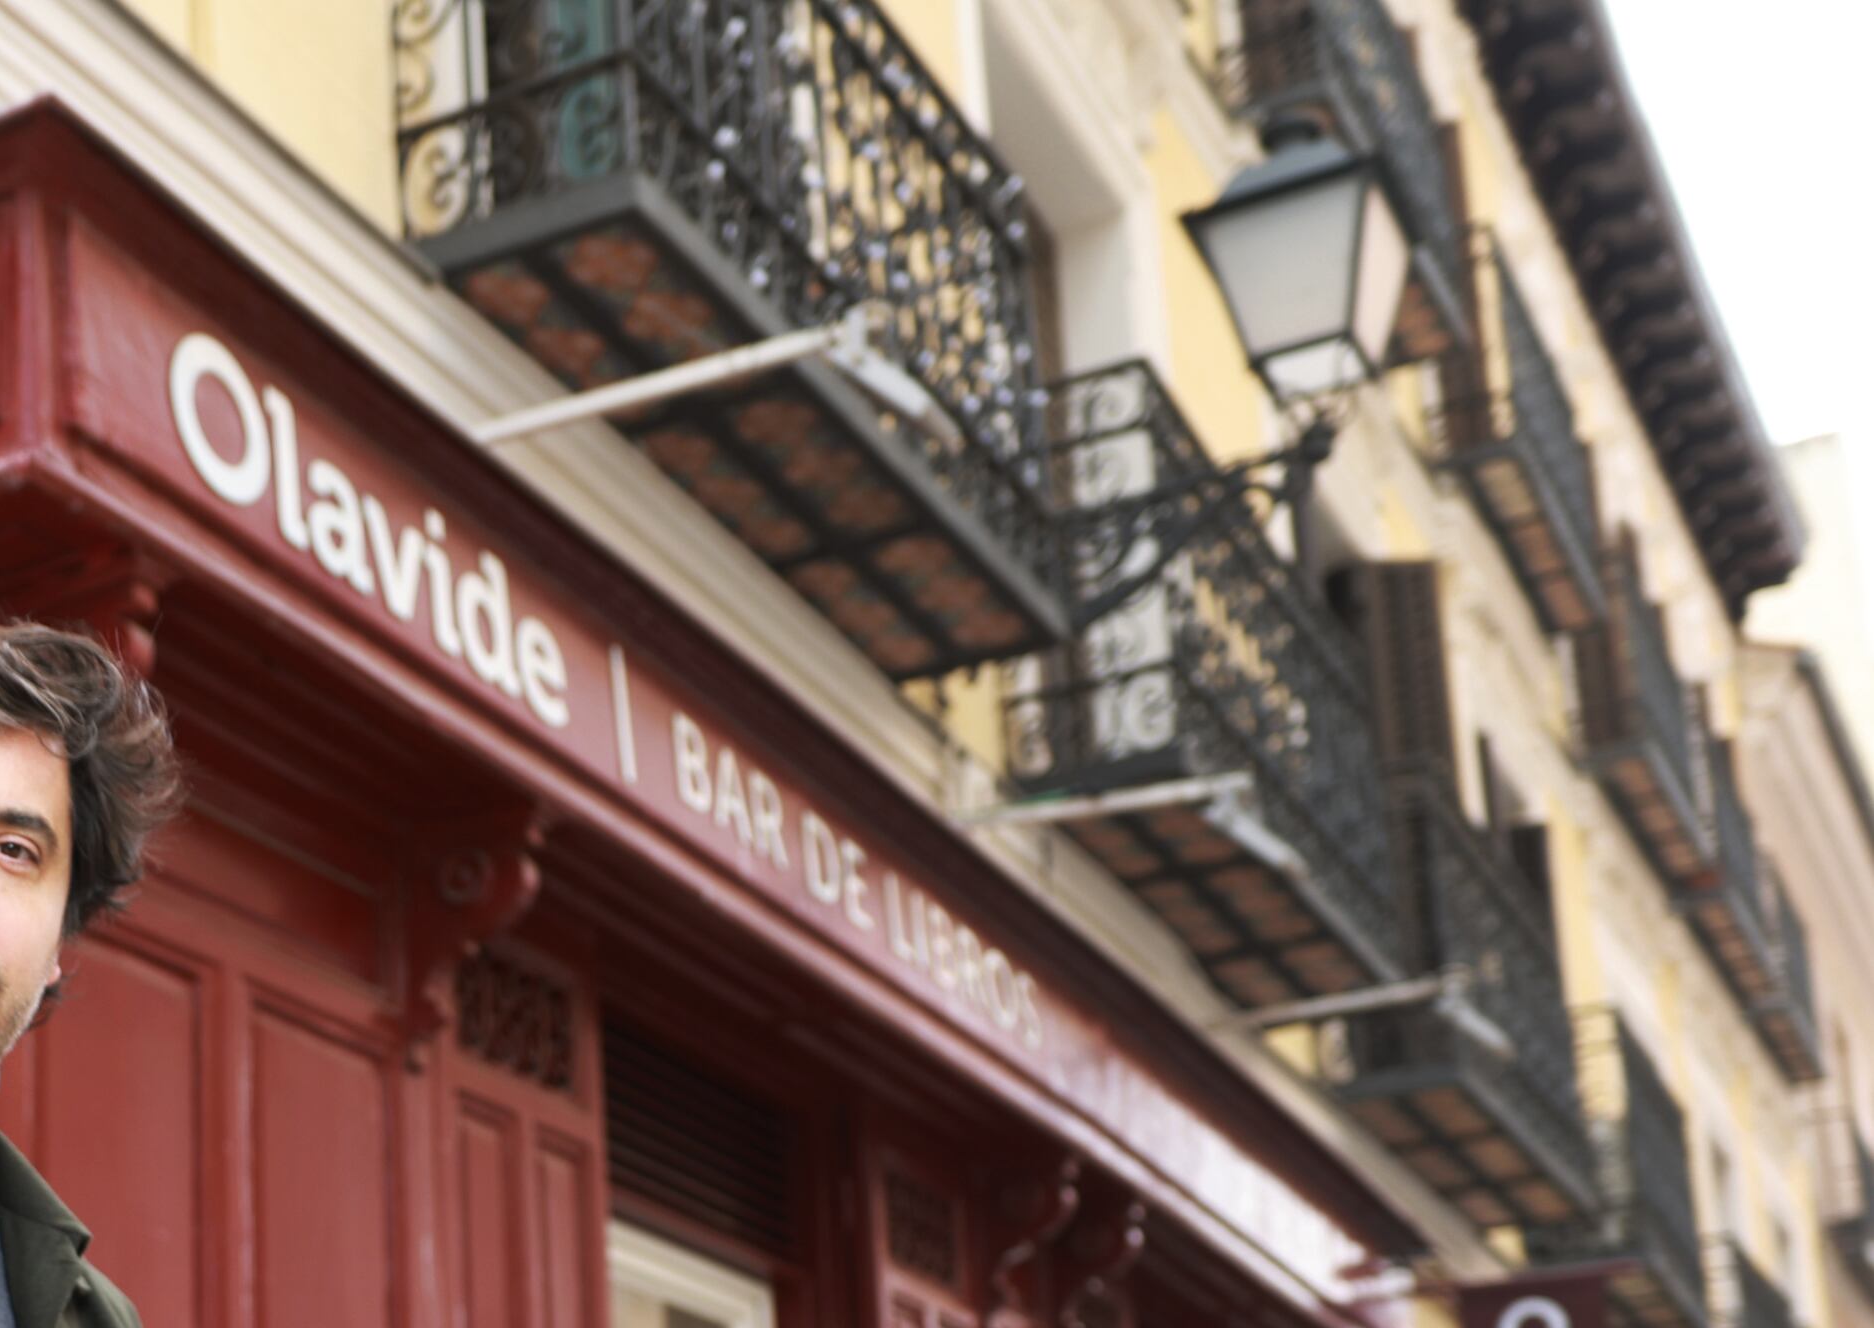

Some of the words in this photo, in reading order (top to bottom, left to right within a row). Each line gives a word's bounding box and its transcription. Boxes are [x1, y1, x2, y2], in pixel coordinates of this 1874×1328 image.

[169, 332, 570, 729] Olavide
[672, 711, 789, 872] BAR
[801, 810, 875, 932] DE
[882, 870, 1042, 1049] LIBROS
